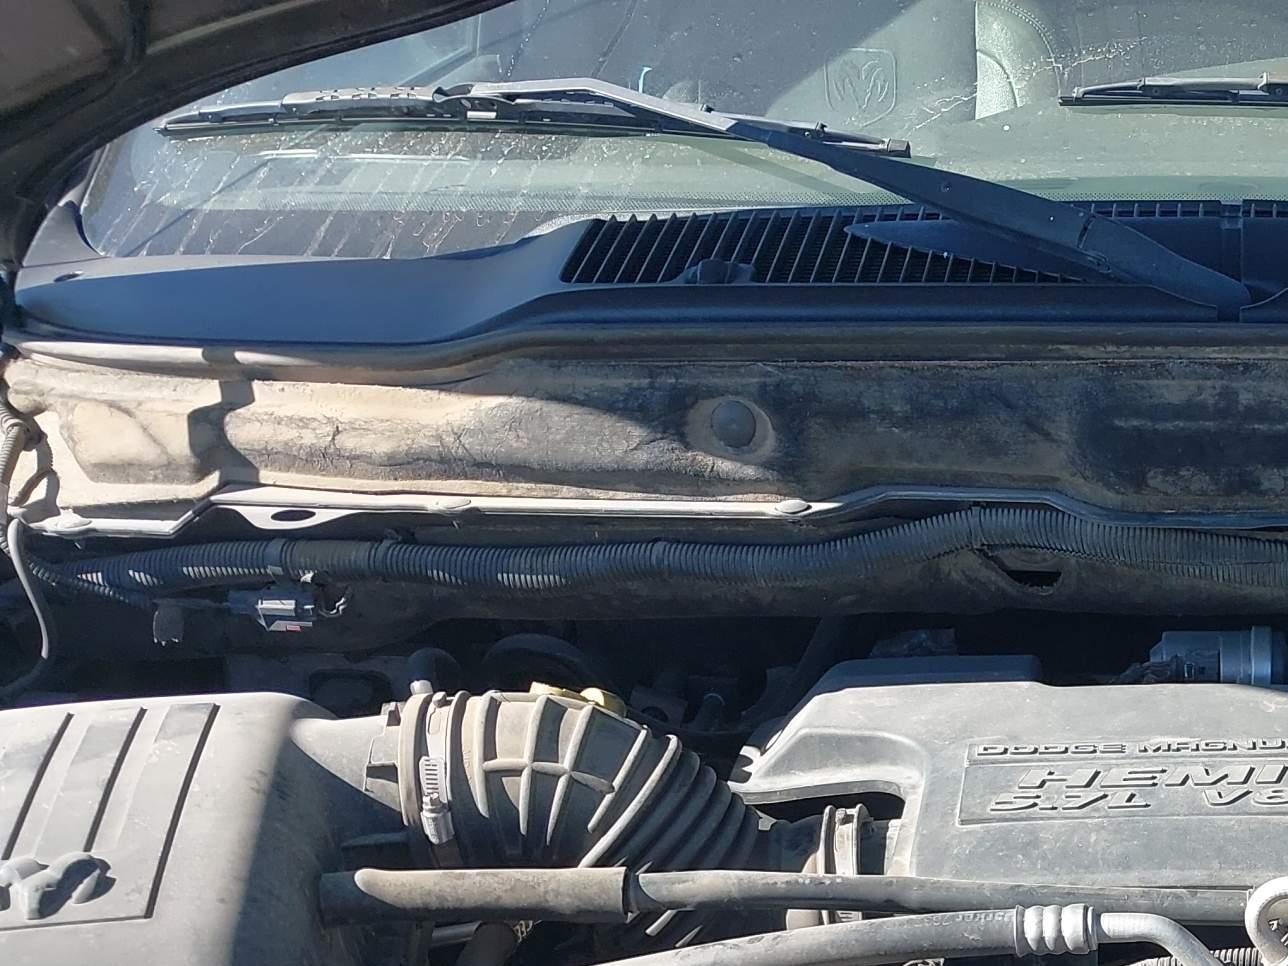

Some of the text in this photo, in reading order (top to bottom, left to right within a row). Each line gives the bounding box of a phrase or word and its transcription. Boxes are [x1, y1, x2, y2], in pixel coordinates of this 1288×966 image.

[976, 743, 1127, 757] DODGE
[1018, 764, 1288, 790] HEMI
[989, 790, 1152, 812] 5.7L
